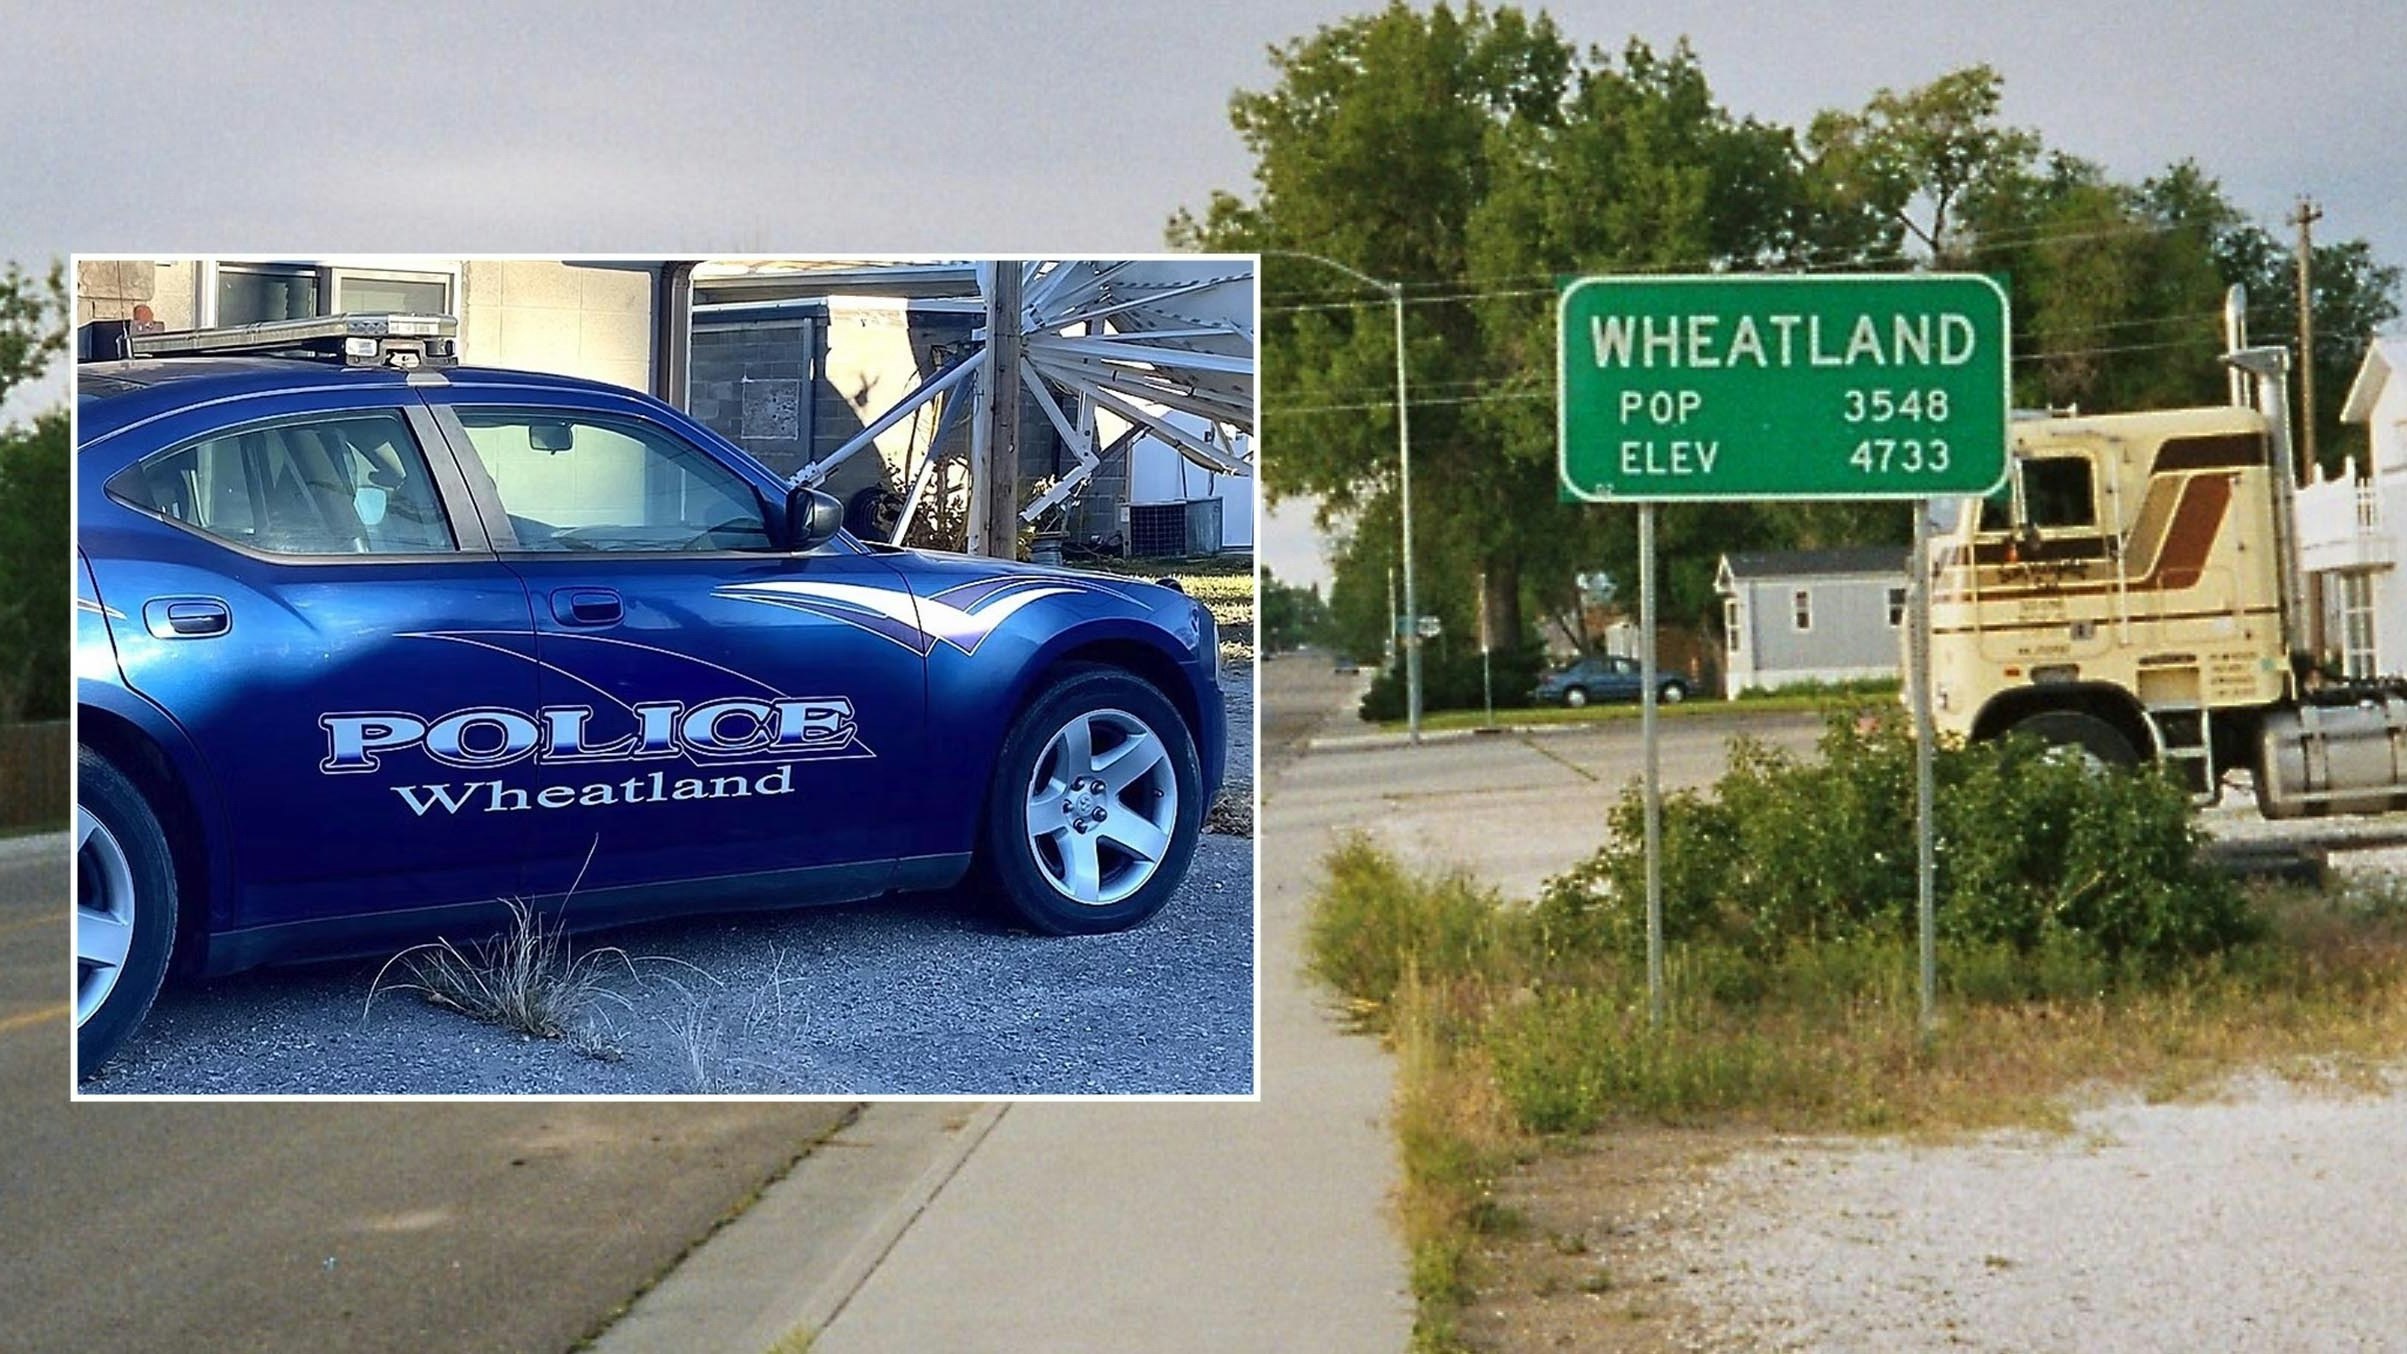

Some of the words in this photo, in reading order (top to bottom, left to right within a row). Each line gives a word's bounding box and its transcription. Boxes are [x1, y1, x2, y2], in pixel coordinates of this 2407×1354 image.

[1591, 313, 1976, 368] WHEATLAND
[1620, 390, 1702, 424] POP
[1844, 389, 1949, 422] 3548
[1621, 441, 1718, 474] ELEV
[1850, 439, 1950, 473] 4733
[320, 696, 856, 773] POLICE
[390, 765, 796, 816] Wheatland
